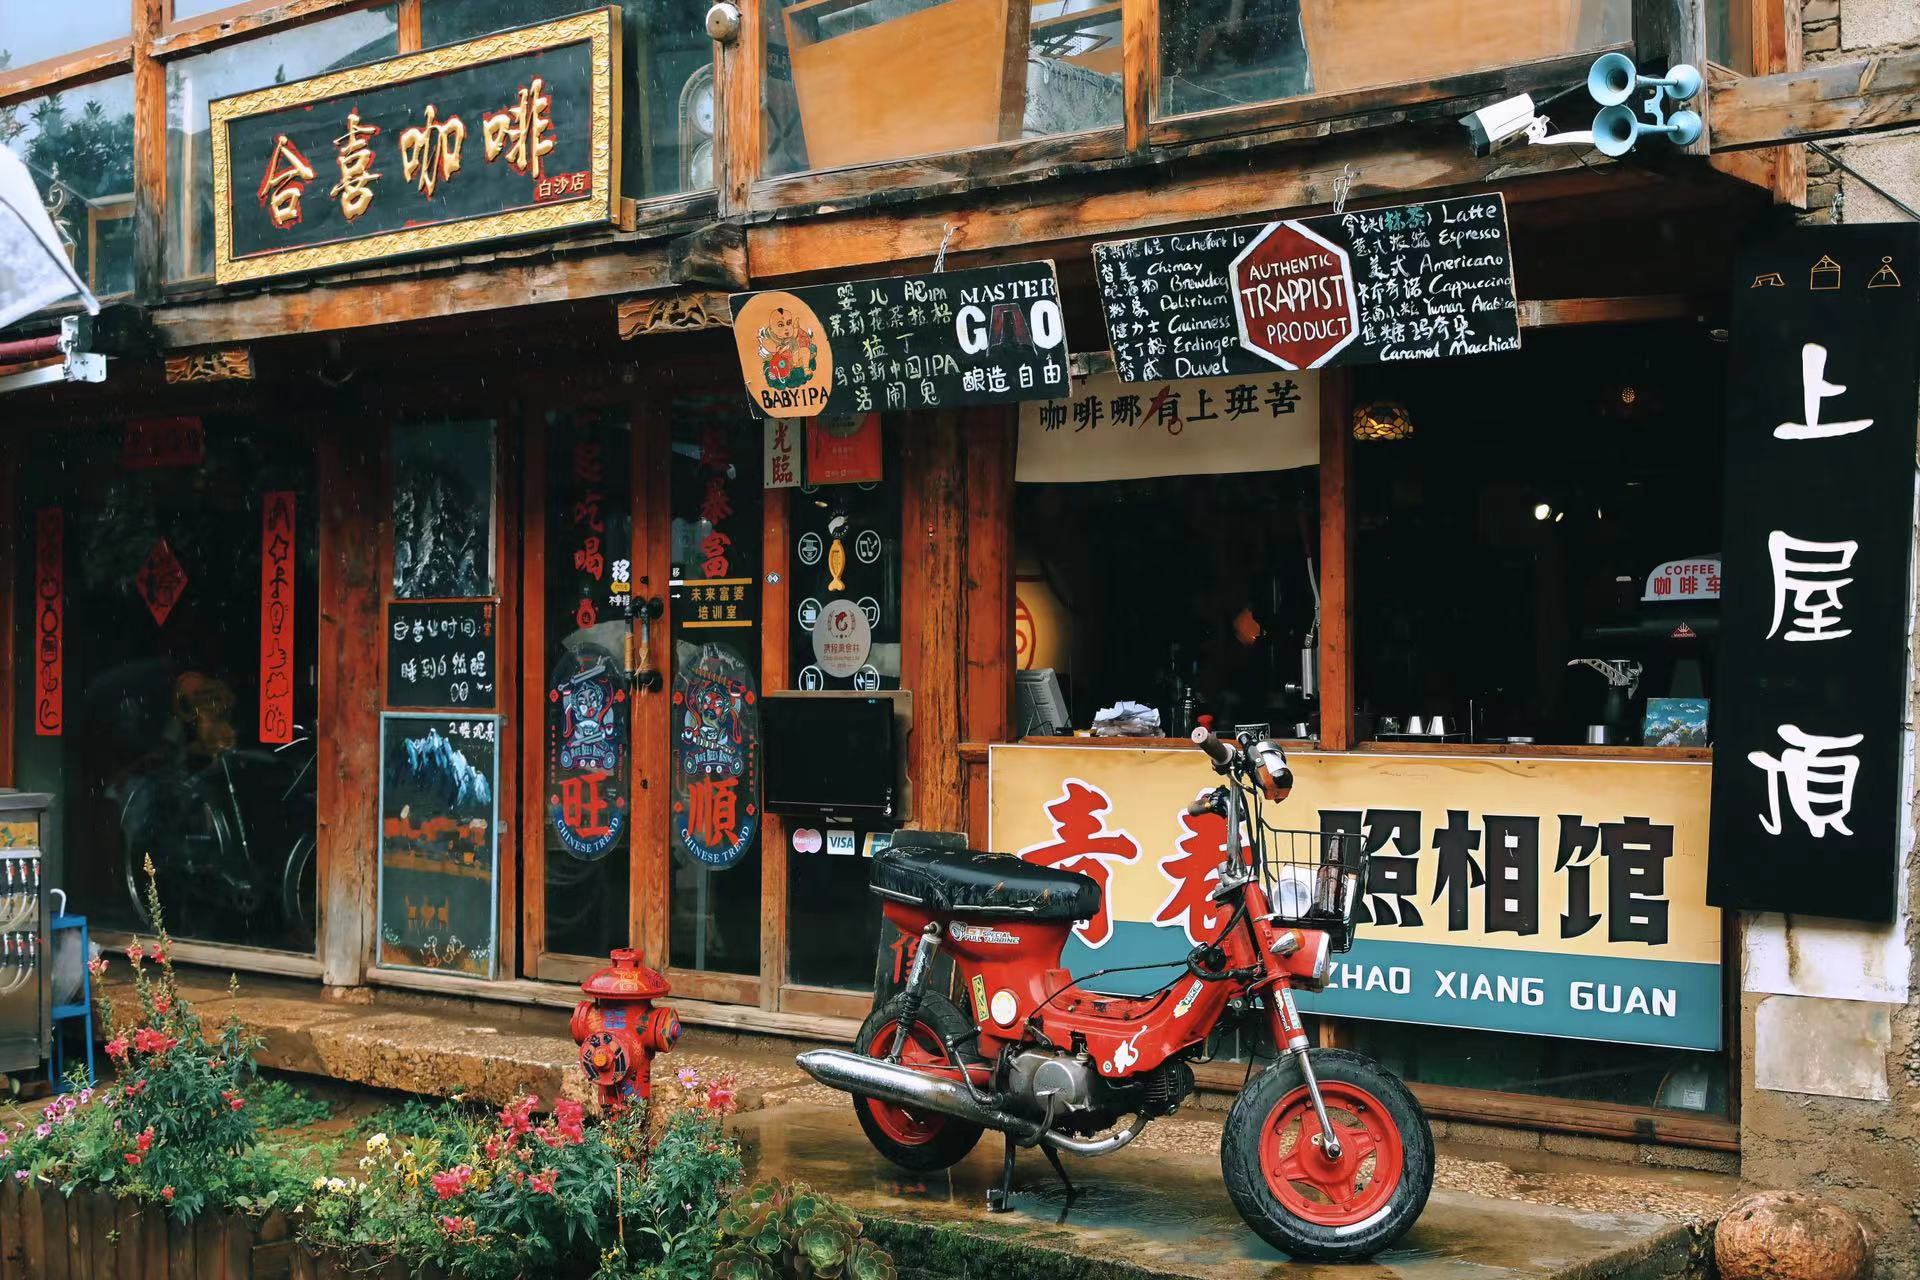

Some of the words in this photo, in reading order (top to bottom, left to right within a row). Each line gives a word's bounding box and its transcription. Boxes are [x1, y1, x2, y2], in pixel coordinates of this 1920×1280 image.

[259, 77, 555, 225] 合喜咖啡
[538, 172, 585, 198] 白沙店
[1442, 203, 1497, 224] Latte
[1438, 228, 1501, 249] Espresso
[1147, 260, 1203, 276] Chimay
[1250, 254, 1333, 281] AUTHENTIC
[1368, 254, 1410, 280] 美式
[1420, 253, 1504, 275] Americano
[960, 277, 1057, 305] MASTER
[1170, 271, 1229, 293] Brewdog
[1357, 276, 1422, 305] 卡布奇诺
[1428, 274, 1513, 299] Cappuccino
[1108, 296, 1149, 318] 粉象
[1160, 293, 1228, 312] Delirium
[1241, 274, 1343, 319] TRAPPIST
[829, 302, 953, 338] 茉莉花茶拉格
[1110, 320, 1160, 340] 健力士
[1168, 314, 1231, 334] Guinness
[1266, 317, 1348, 345] PRODUCT
[1361, 314, 1476, 346] 焦糖玛奇朵
[862, 332, 915, 360] 猛丁
[1114, 337, 1166, 361] 艾丁格
[1173, 335, 1238, 357] Erdinger
[1379, 341, 1441, 361] Caramel
[1449, 335, 1521, 356] Macchiato
[962, 353, 1061, 392] 酿造自由
[1175, 355, 1230, 378] Duvel
[855, 378, 941, 412] 活闹鬼
[1039, 379, 1302, 433] 咖啡哪有上班苦
[1664, 564, 1715, 576] COFFEE
[691, 585, 745, 602] 未来富婆
[1653, 574, 1721, 596] 咖啡车
[1746, 342, 1875, 839] 上屋頂
[697, 604, 738, 620] 培训室
[401, 651, 487, 683] 睡到自然醒
[558, 770, 609, 839] 旺
[688, 775, 739, 848] 順
[557, 819, 592, 853] CHINESE
[593, 817, 619, 851] TREND
[681, 827, 720, 863] CHINESE
[722, 826, 749, 861] TREND
[829, 836, 854, 848] VISA
[1435, 970, 1544, 1007] XIANG
[1569, 981, 1677, 1017] GUAN
